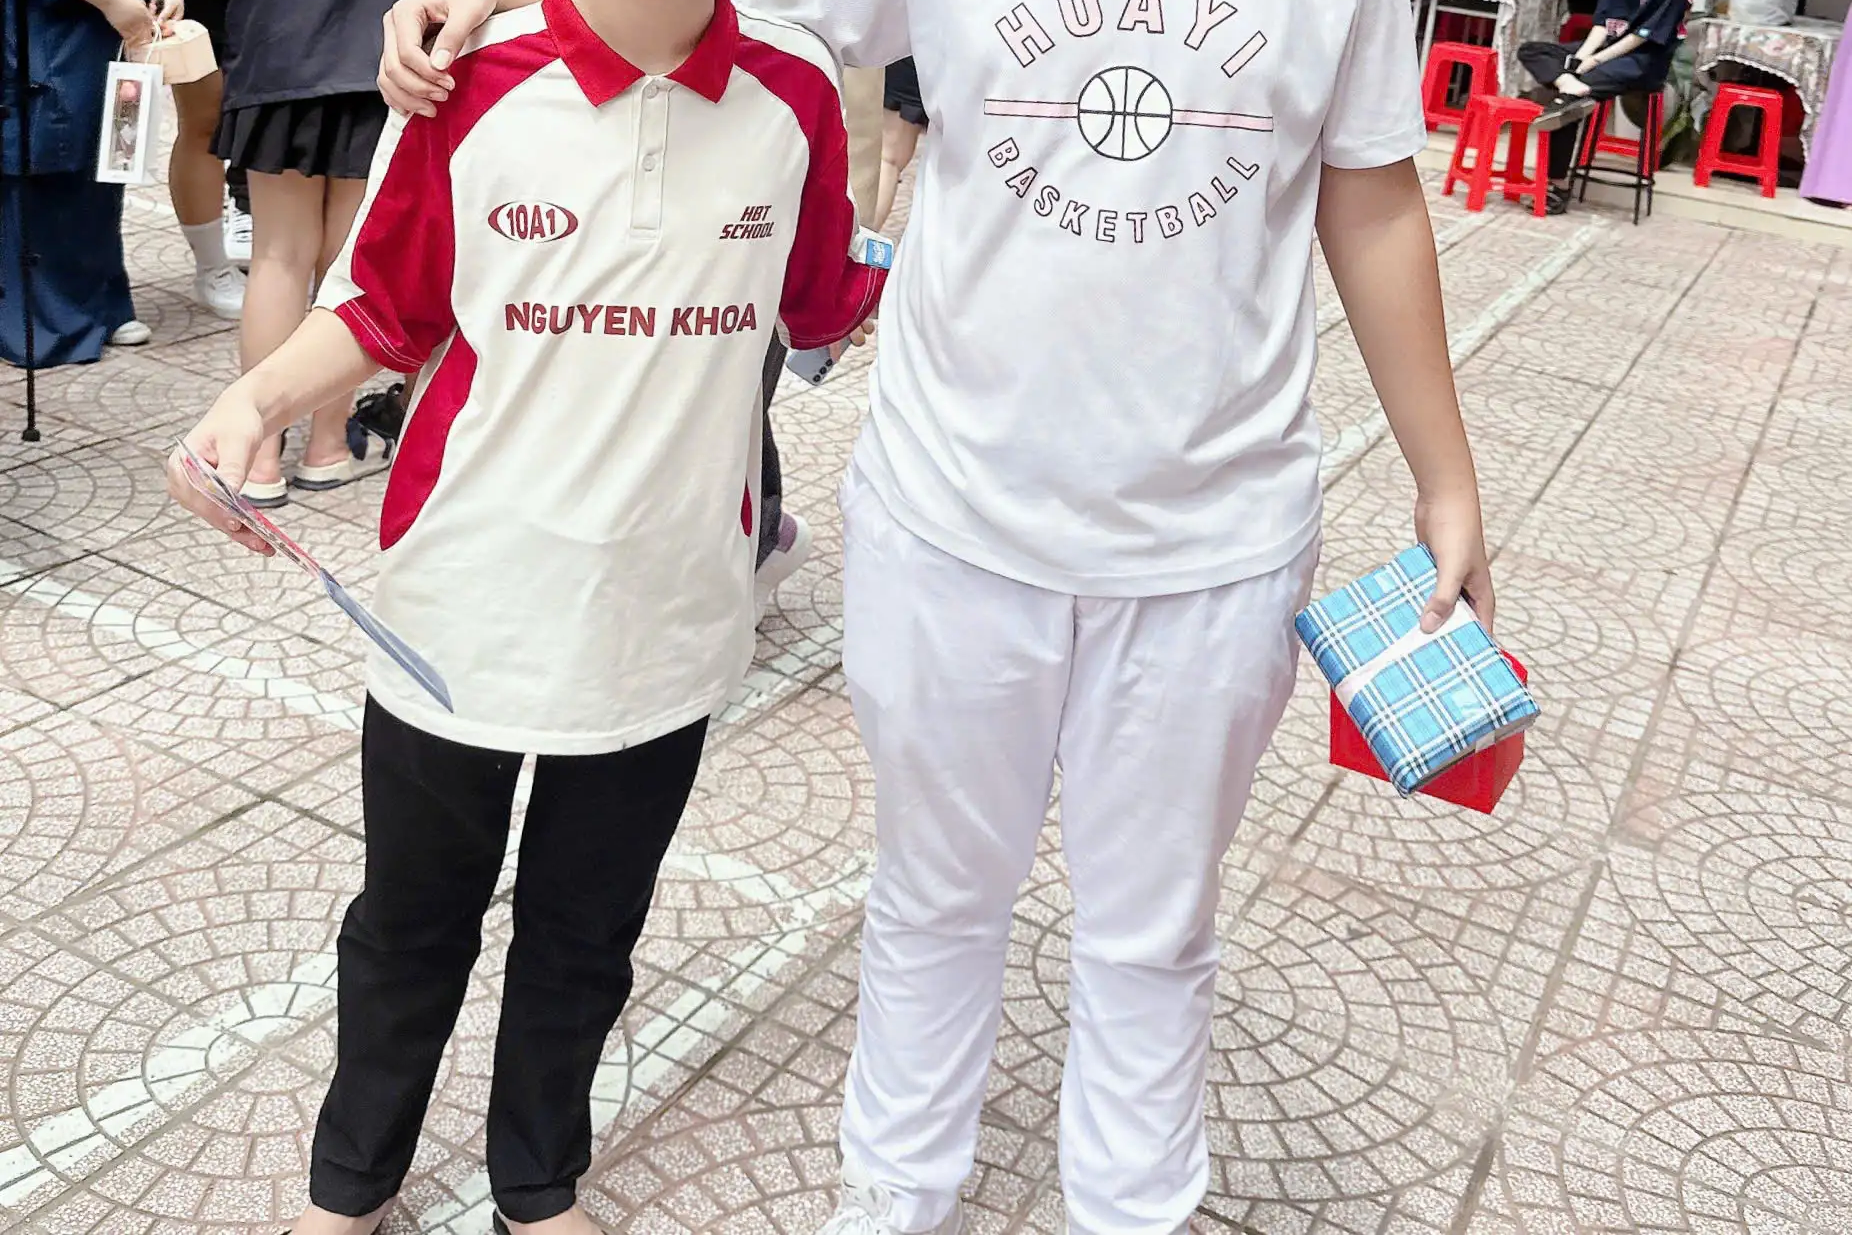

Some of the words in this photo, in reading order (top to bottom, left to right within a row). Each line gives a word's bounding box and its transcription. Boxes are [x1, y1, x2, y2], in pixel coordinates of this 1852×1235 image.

[988, 136, 1260, 244] BASKETBALL
[505, 204, 556, 240] 10A1
[719, 222, 774, 239] SCHOOL
[740, 205, 772, 221] HBT
[505, 302, 656, 337] NGUYEN
[670, 302, 757, 336] KHOA
